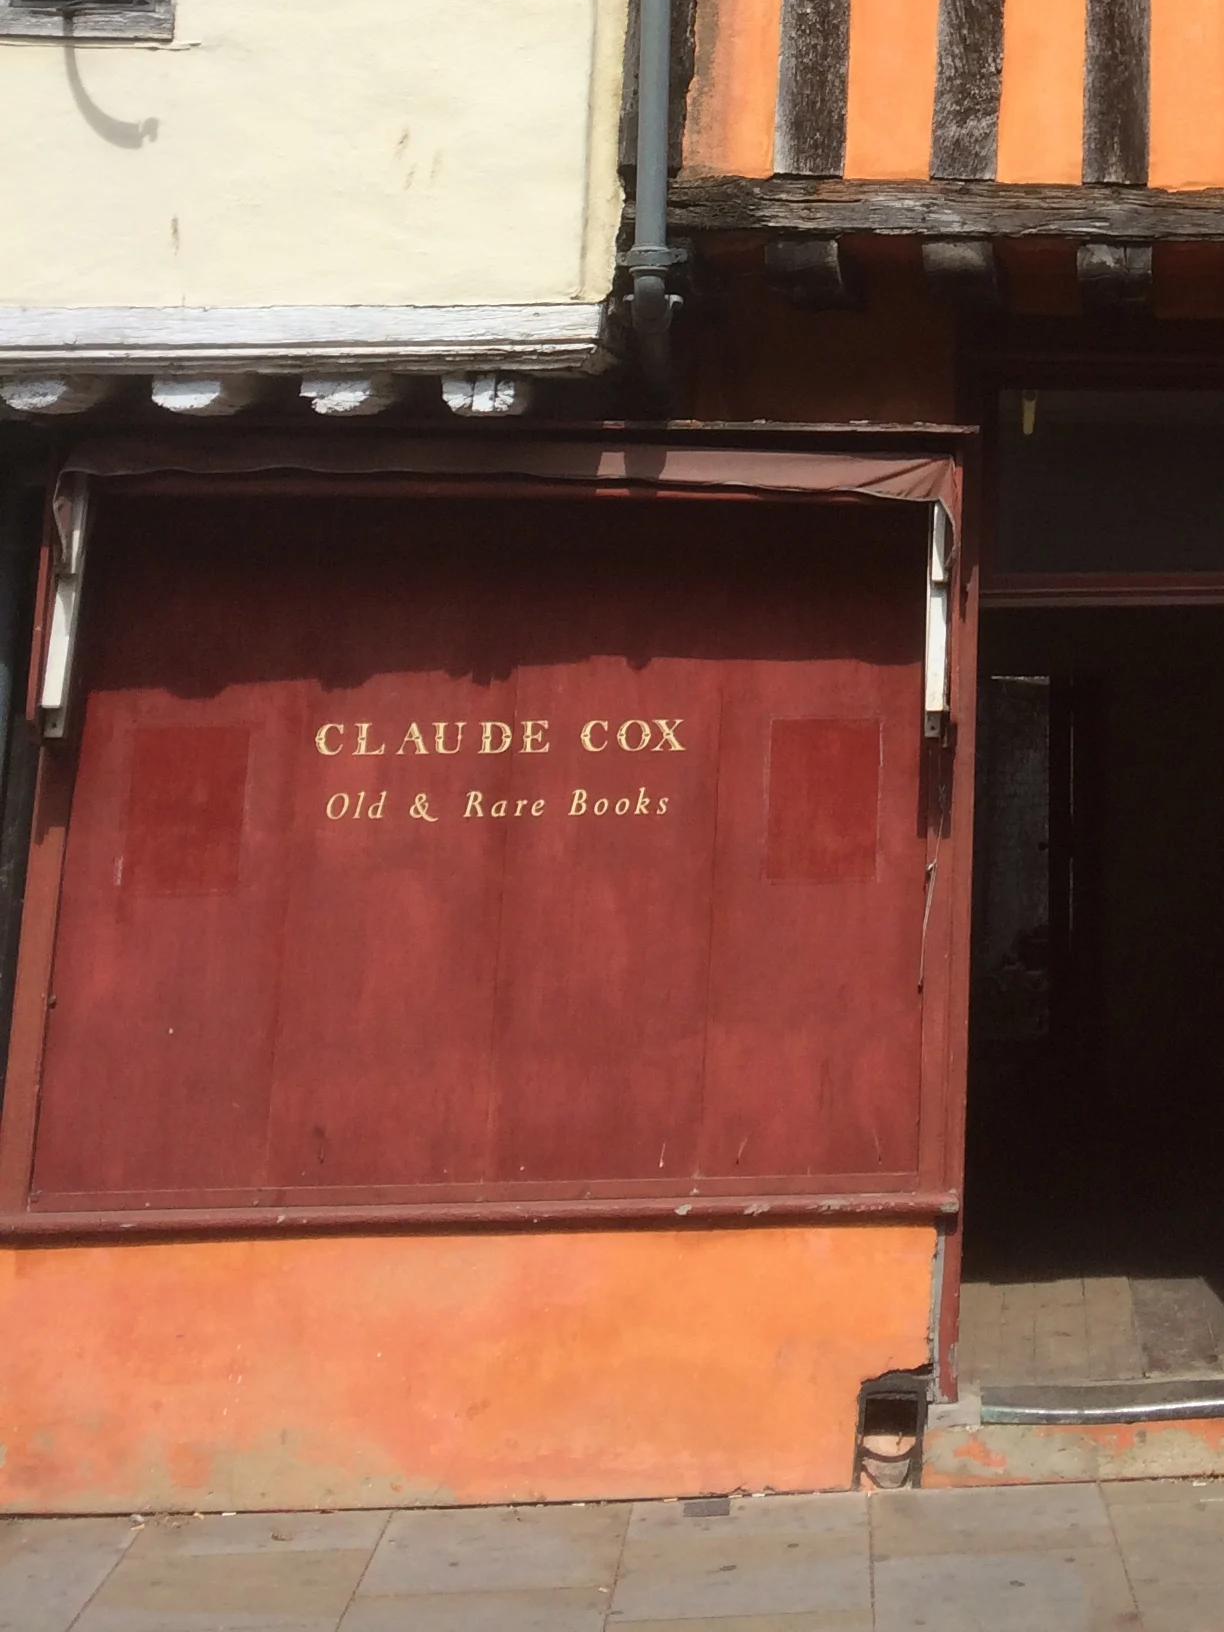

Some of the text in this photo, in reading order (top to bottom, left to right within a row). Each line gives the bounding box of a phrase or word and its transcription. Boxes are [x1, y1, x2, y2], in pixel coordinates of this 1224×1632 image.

[314, 718, 686, 756] CLAUDE COX
[325, 786, 669, 823] Old & Rare Books
